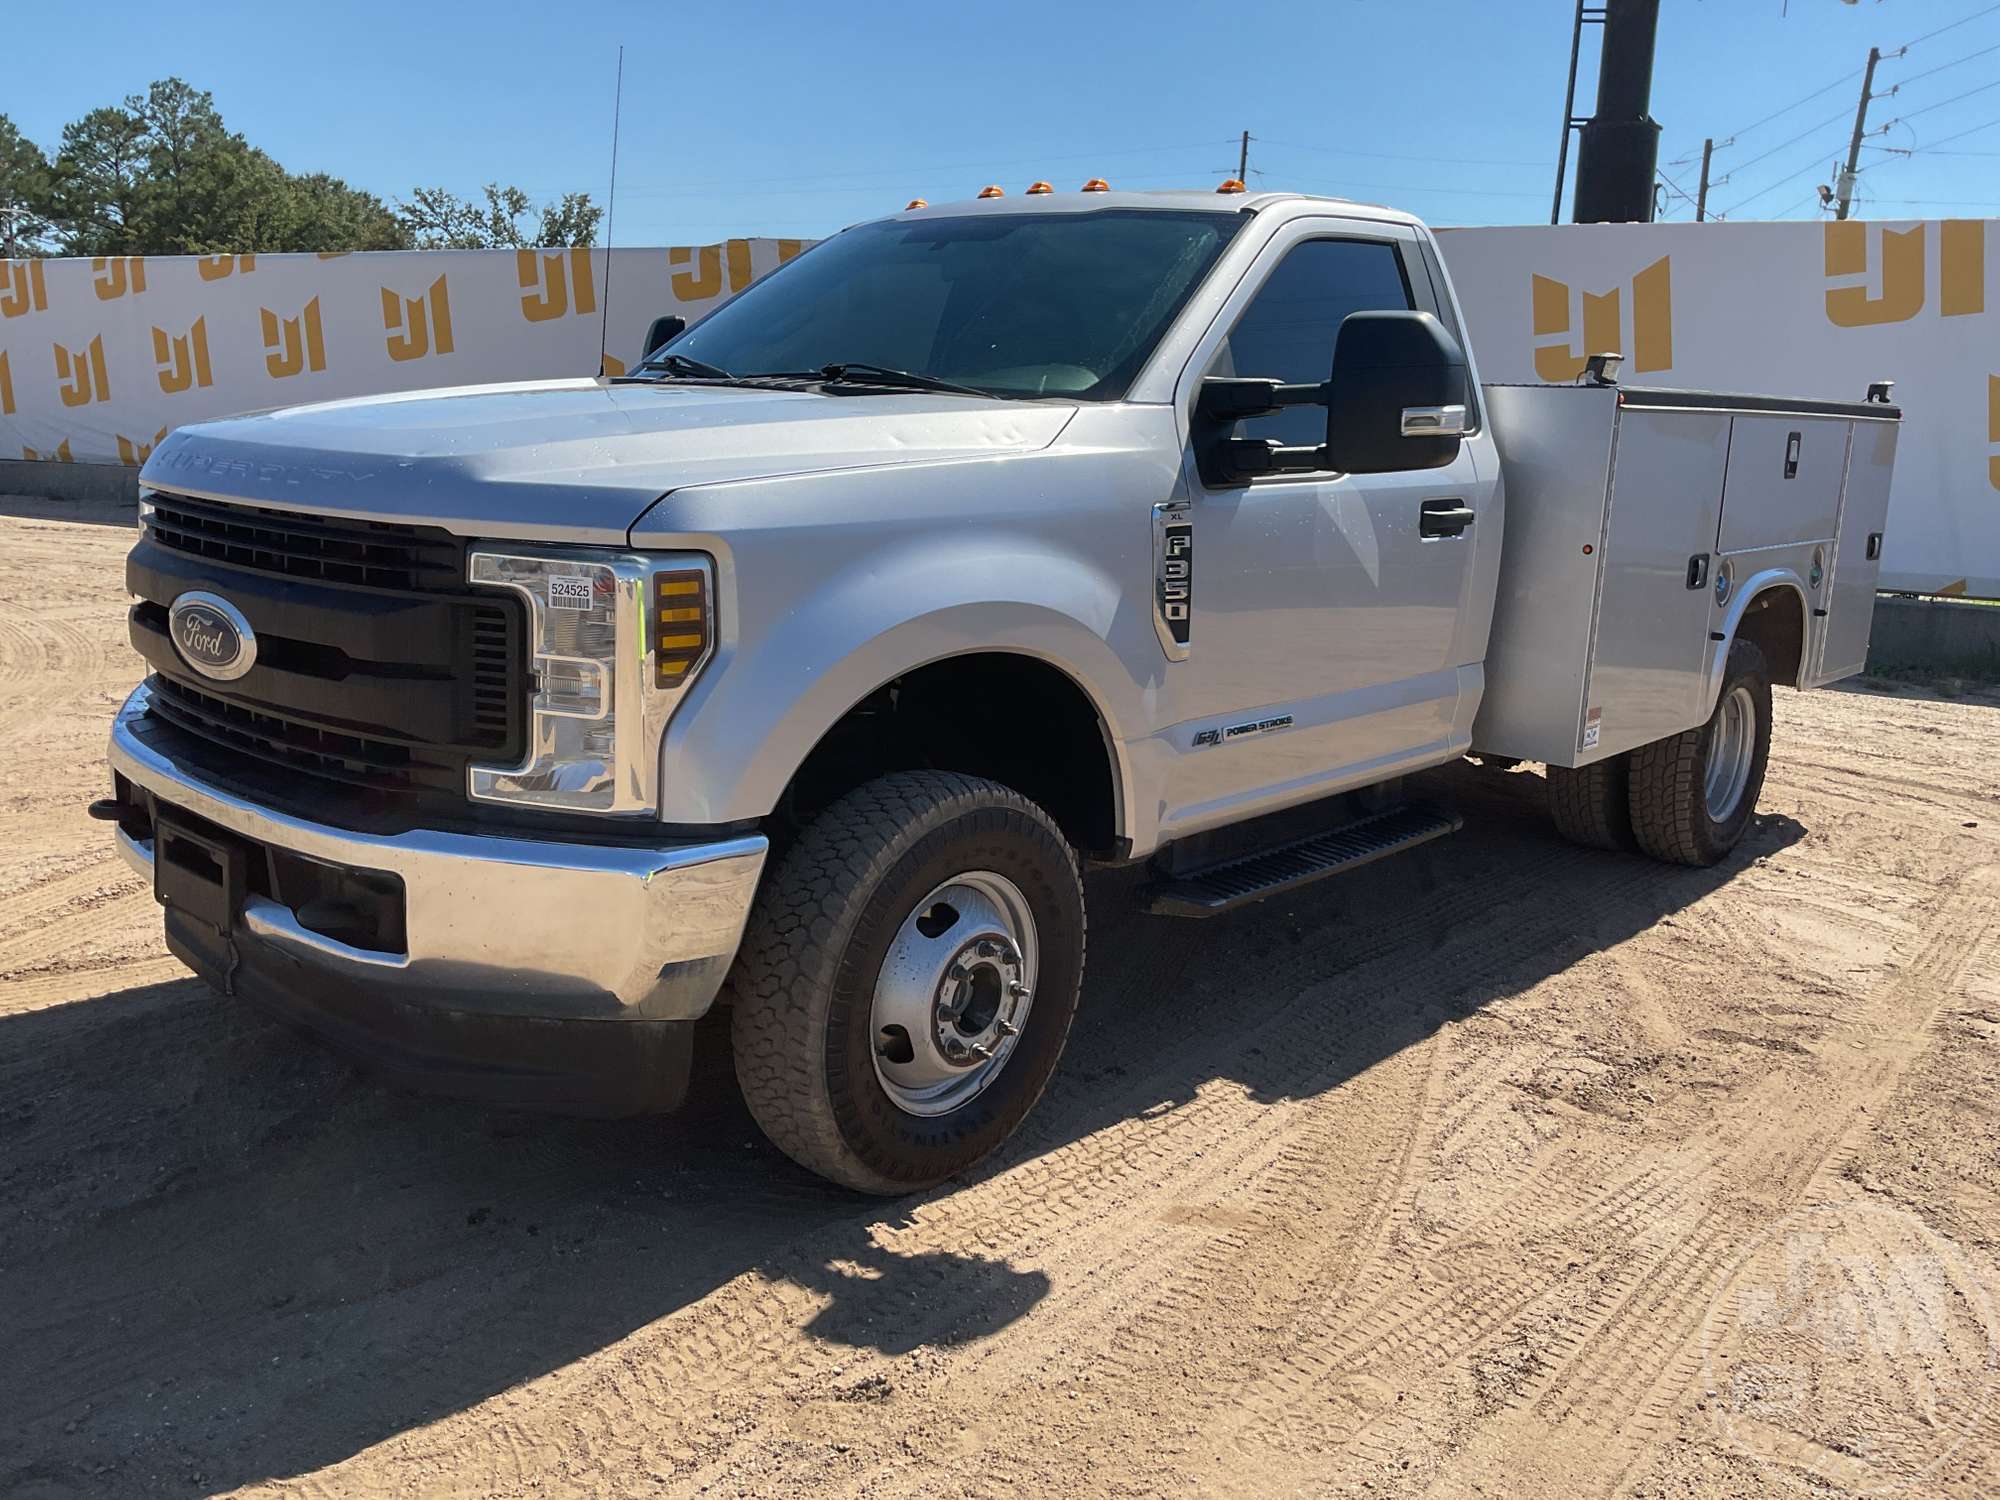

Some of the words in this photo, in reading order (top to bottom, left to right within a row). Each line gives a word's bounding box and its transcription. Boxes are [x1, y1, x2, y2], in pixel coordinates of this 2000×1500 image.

[551, 583, 589, 597] 524525
[184, 613, 222, 656] Ford
[1226, 723, 1257, 737] POWER
[1258, 715, 1293, 730] STROKE
